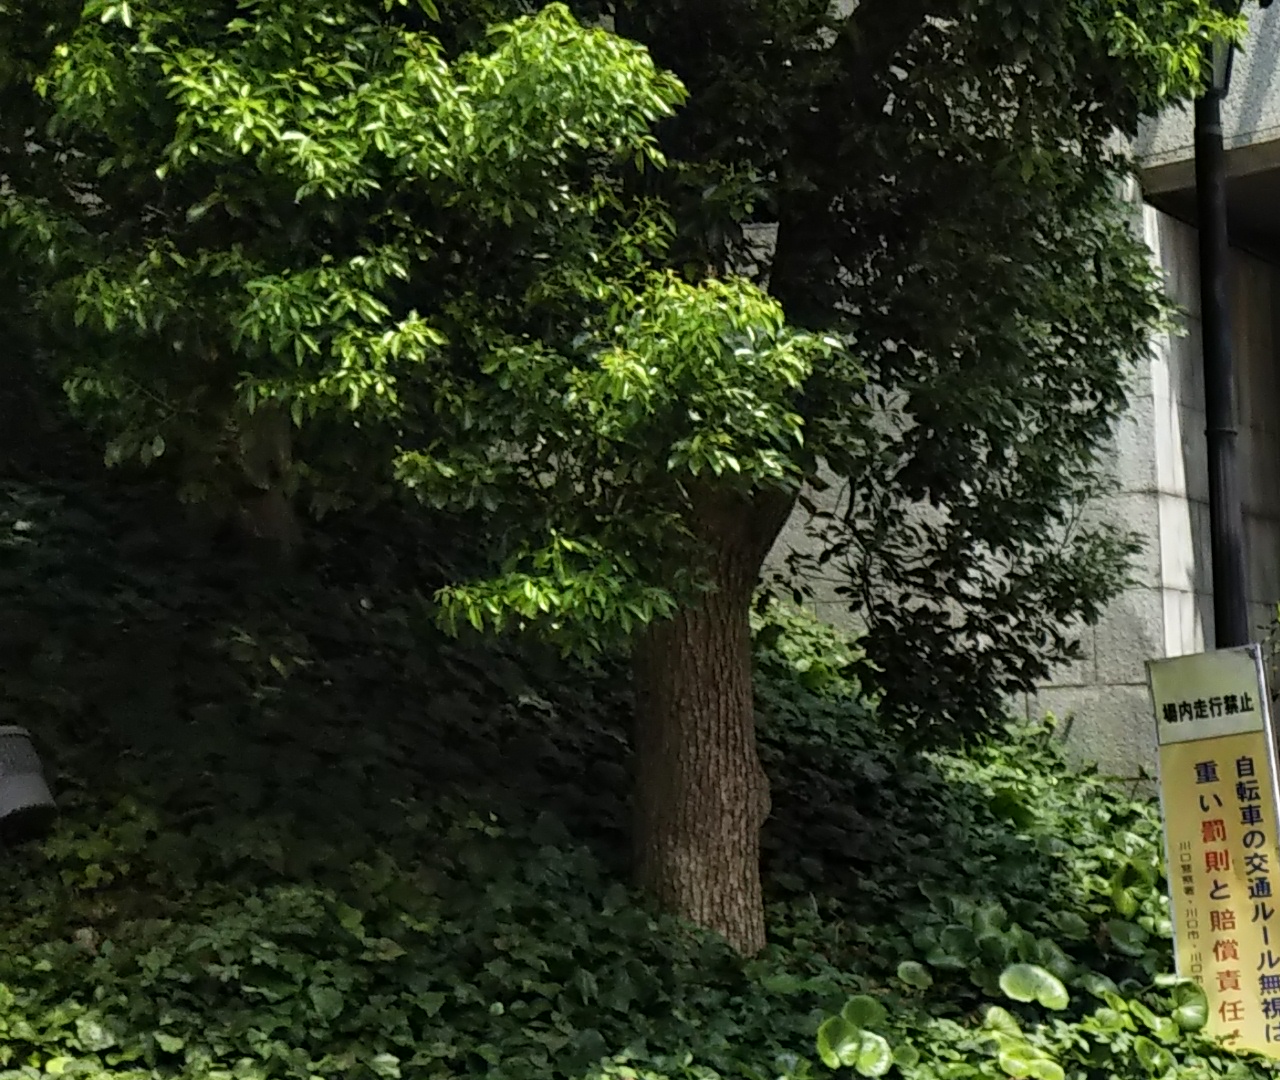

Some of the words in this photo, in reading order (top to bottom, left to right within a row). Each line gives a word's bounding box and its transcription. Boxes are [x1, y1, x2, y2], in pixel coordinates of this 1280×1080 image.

[1163, 692, 1254, 723] 場内走行禁止
